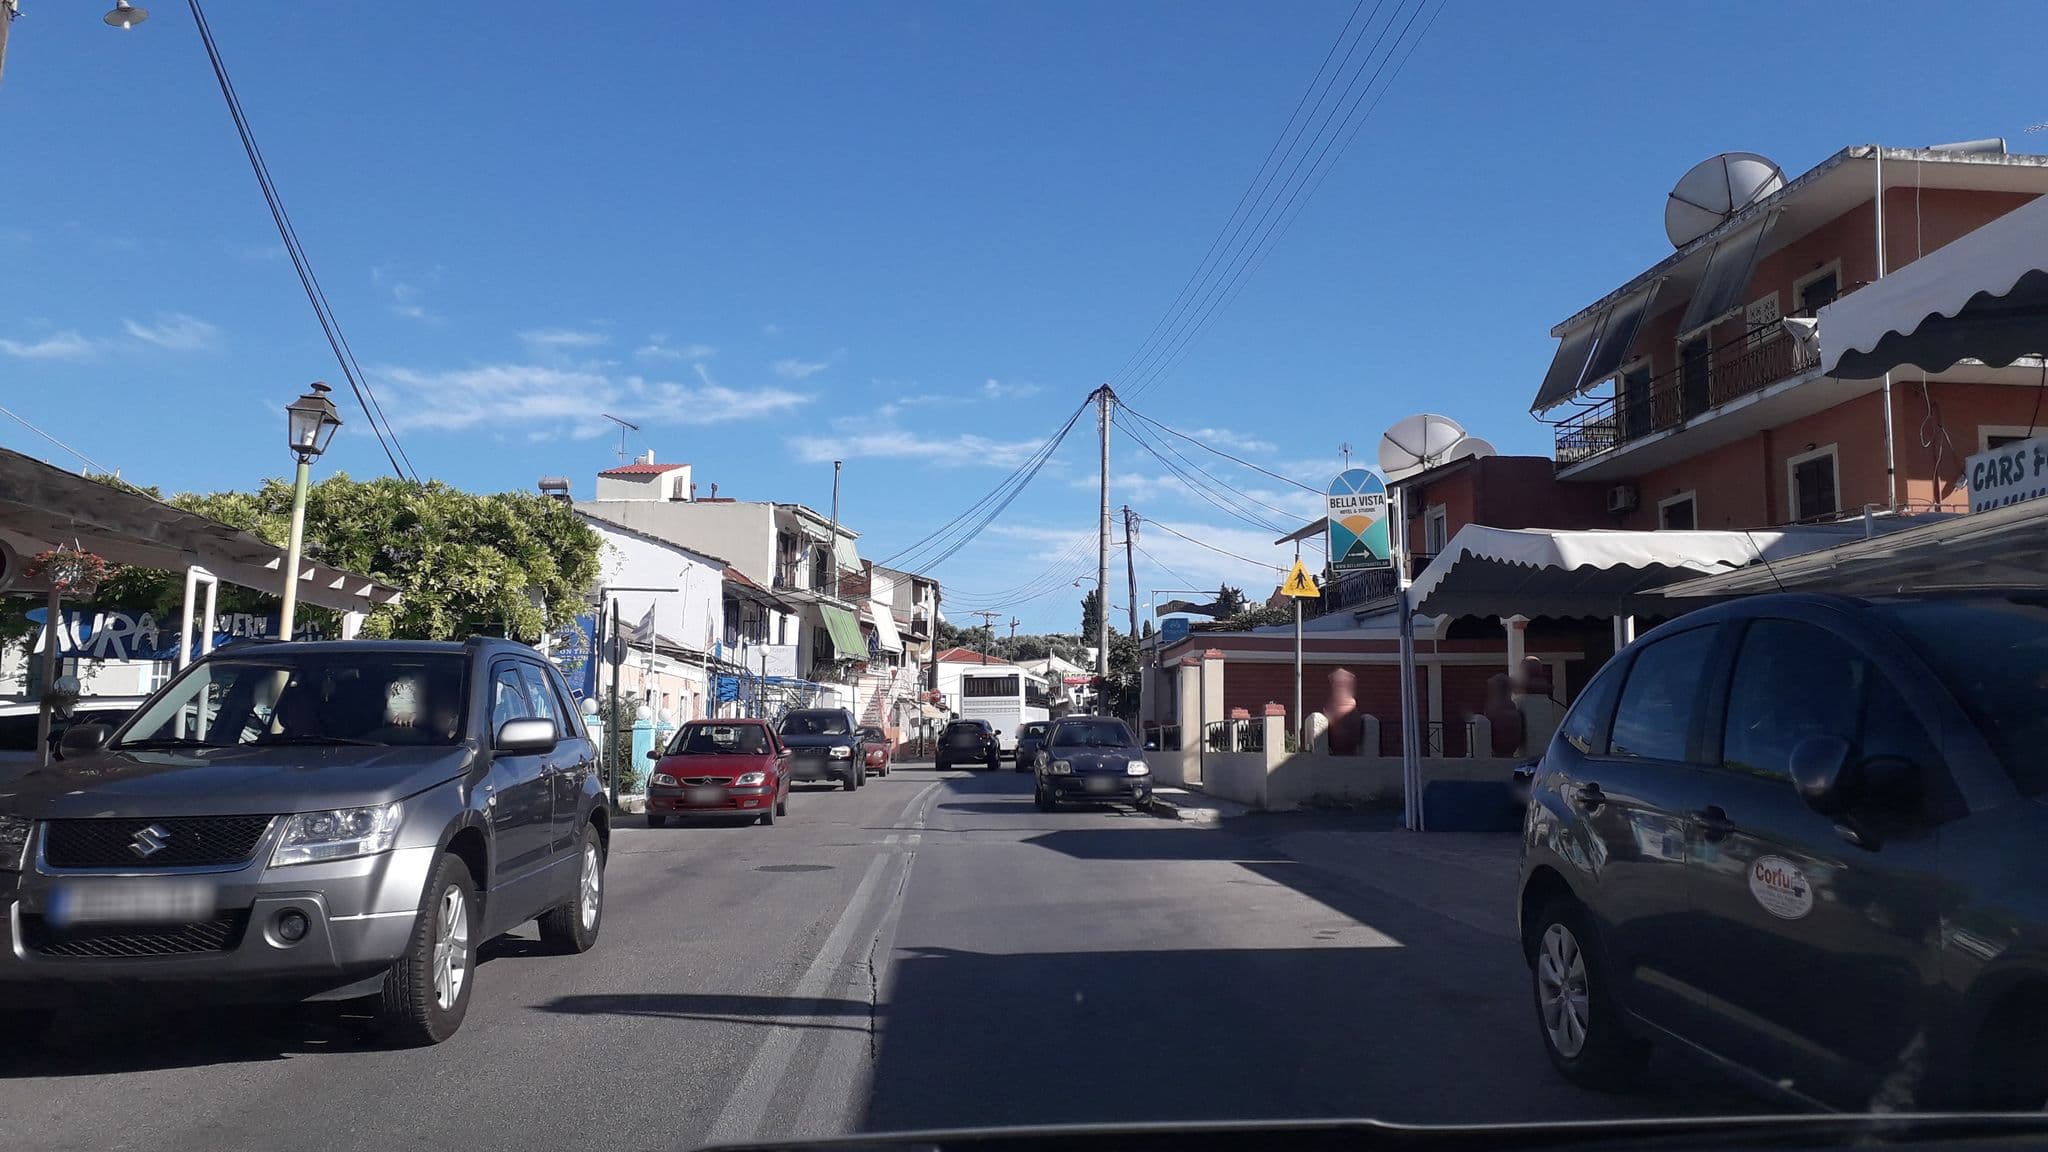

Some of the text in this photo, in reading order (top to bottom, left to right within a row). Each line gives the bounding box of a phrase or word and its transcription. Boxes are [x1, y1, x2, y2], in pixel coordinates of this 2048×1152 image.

[1973, 446, 2048, 492] CARS F
[1330, 495, 1384, 509] BELLA VISTA
